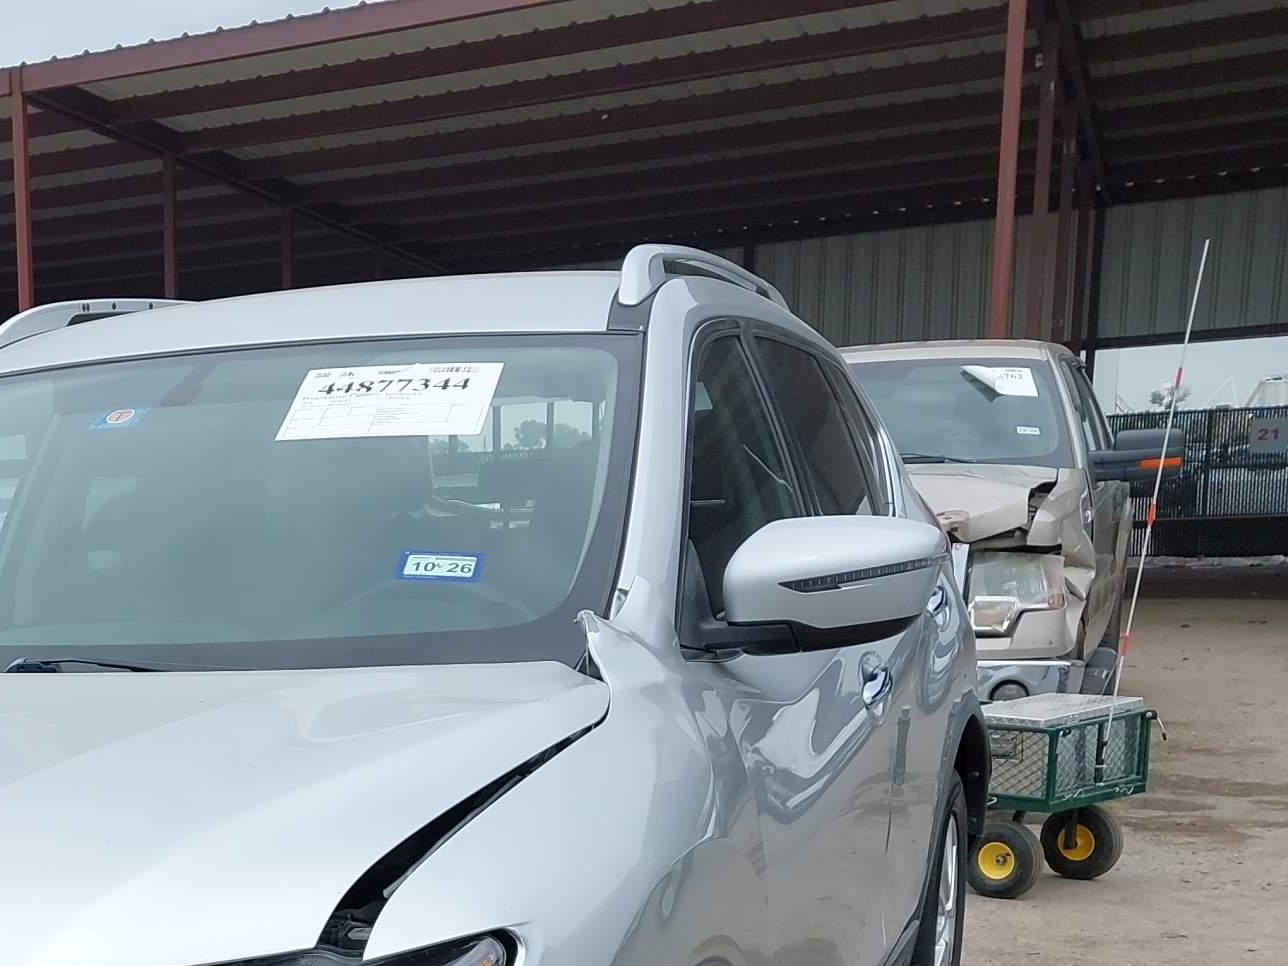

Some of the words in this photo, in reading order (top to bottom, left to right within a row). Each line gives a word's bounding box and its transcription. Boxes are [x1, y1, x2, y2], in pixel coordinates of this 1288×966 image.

[318, 378, 470, 394] 44877344
[1257, 428, 1279, 441] 21
[412, 561, 436, 572] 10
[445, 562, 473, 574] 26
